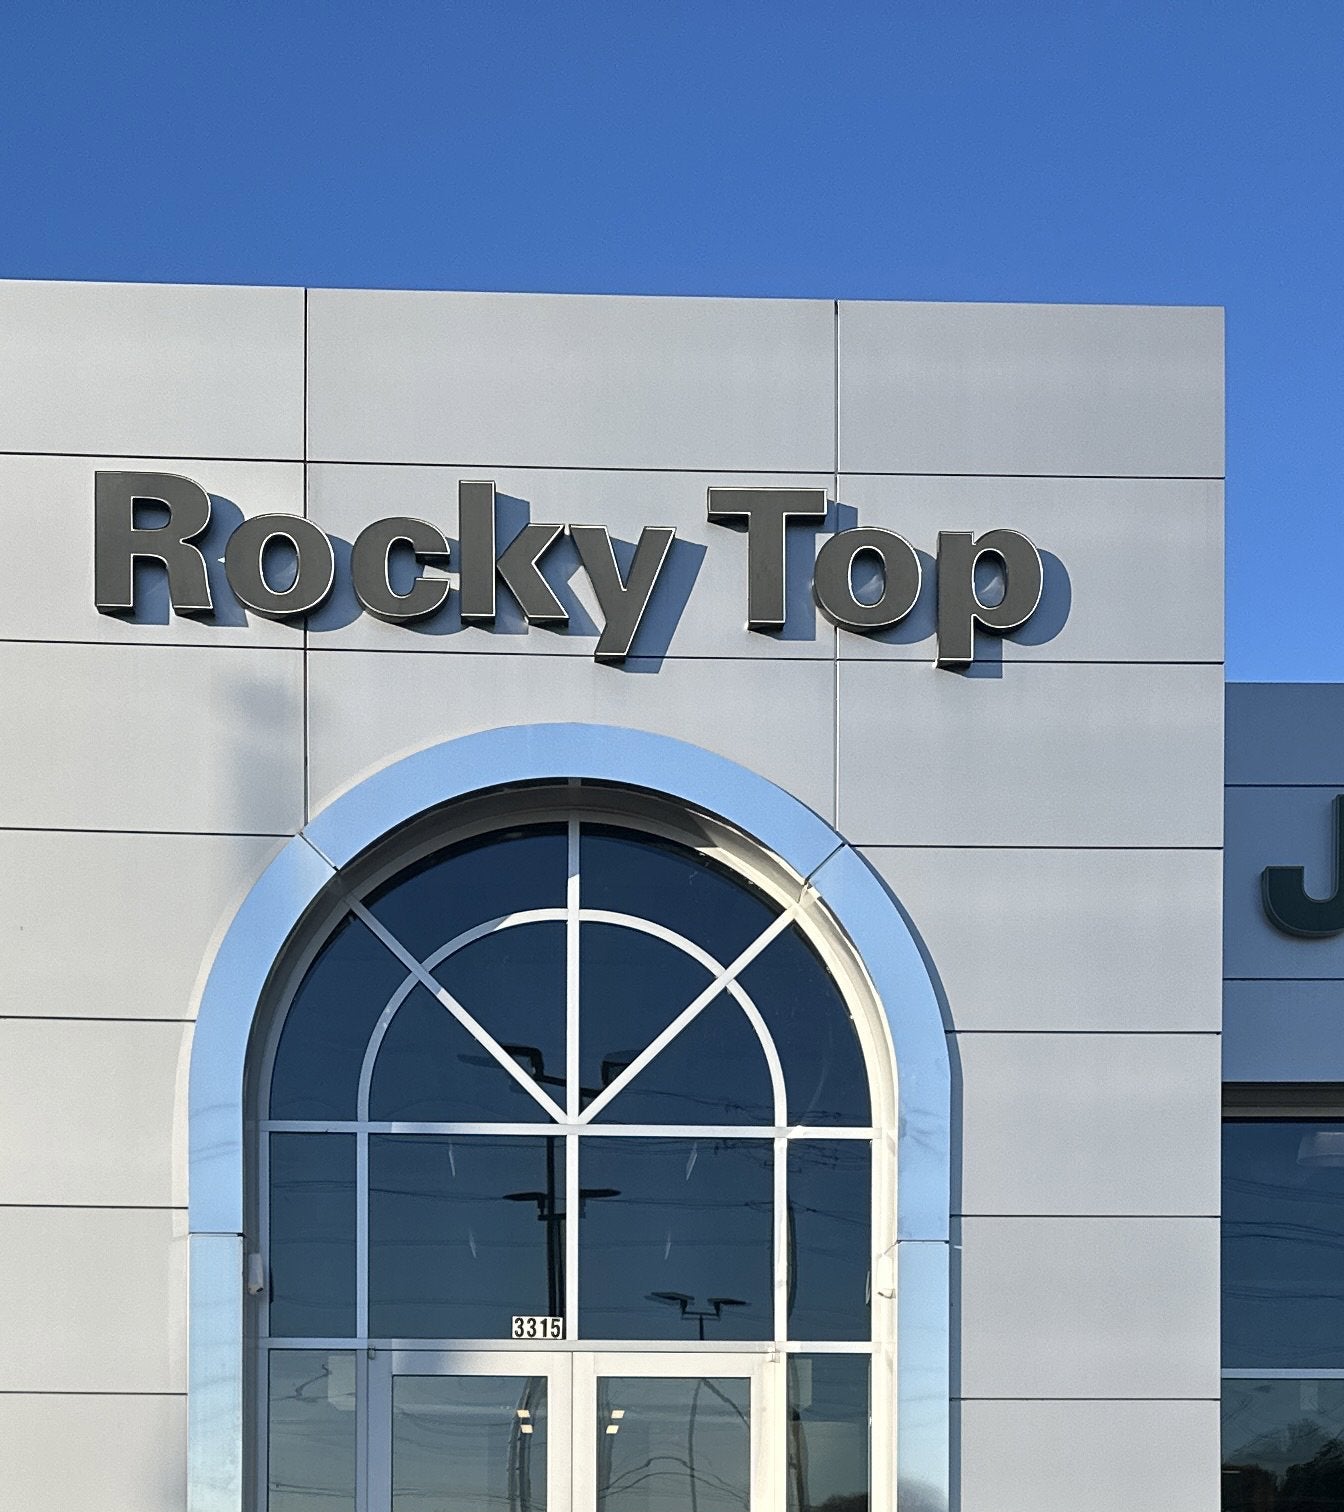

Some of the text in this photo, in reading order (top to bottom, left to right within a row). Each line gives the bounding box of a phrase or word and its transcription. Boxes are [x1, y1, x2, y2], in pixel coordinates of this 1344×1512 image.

[93, 470, 1045, 669] Rocky Top
[514, 1317, 561, 1338] 3315
